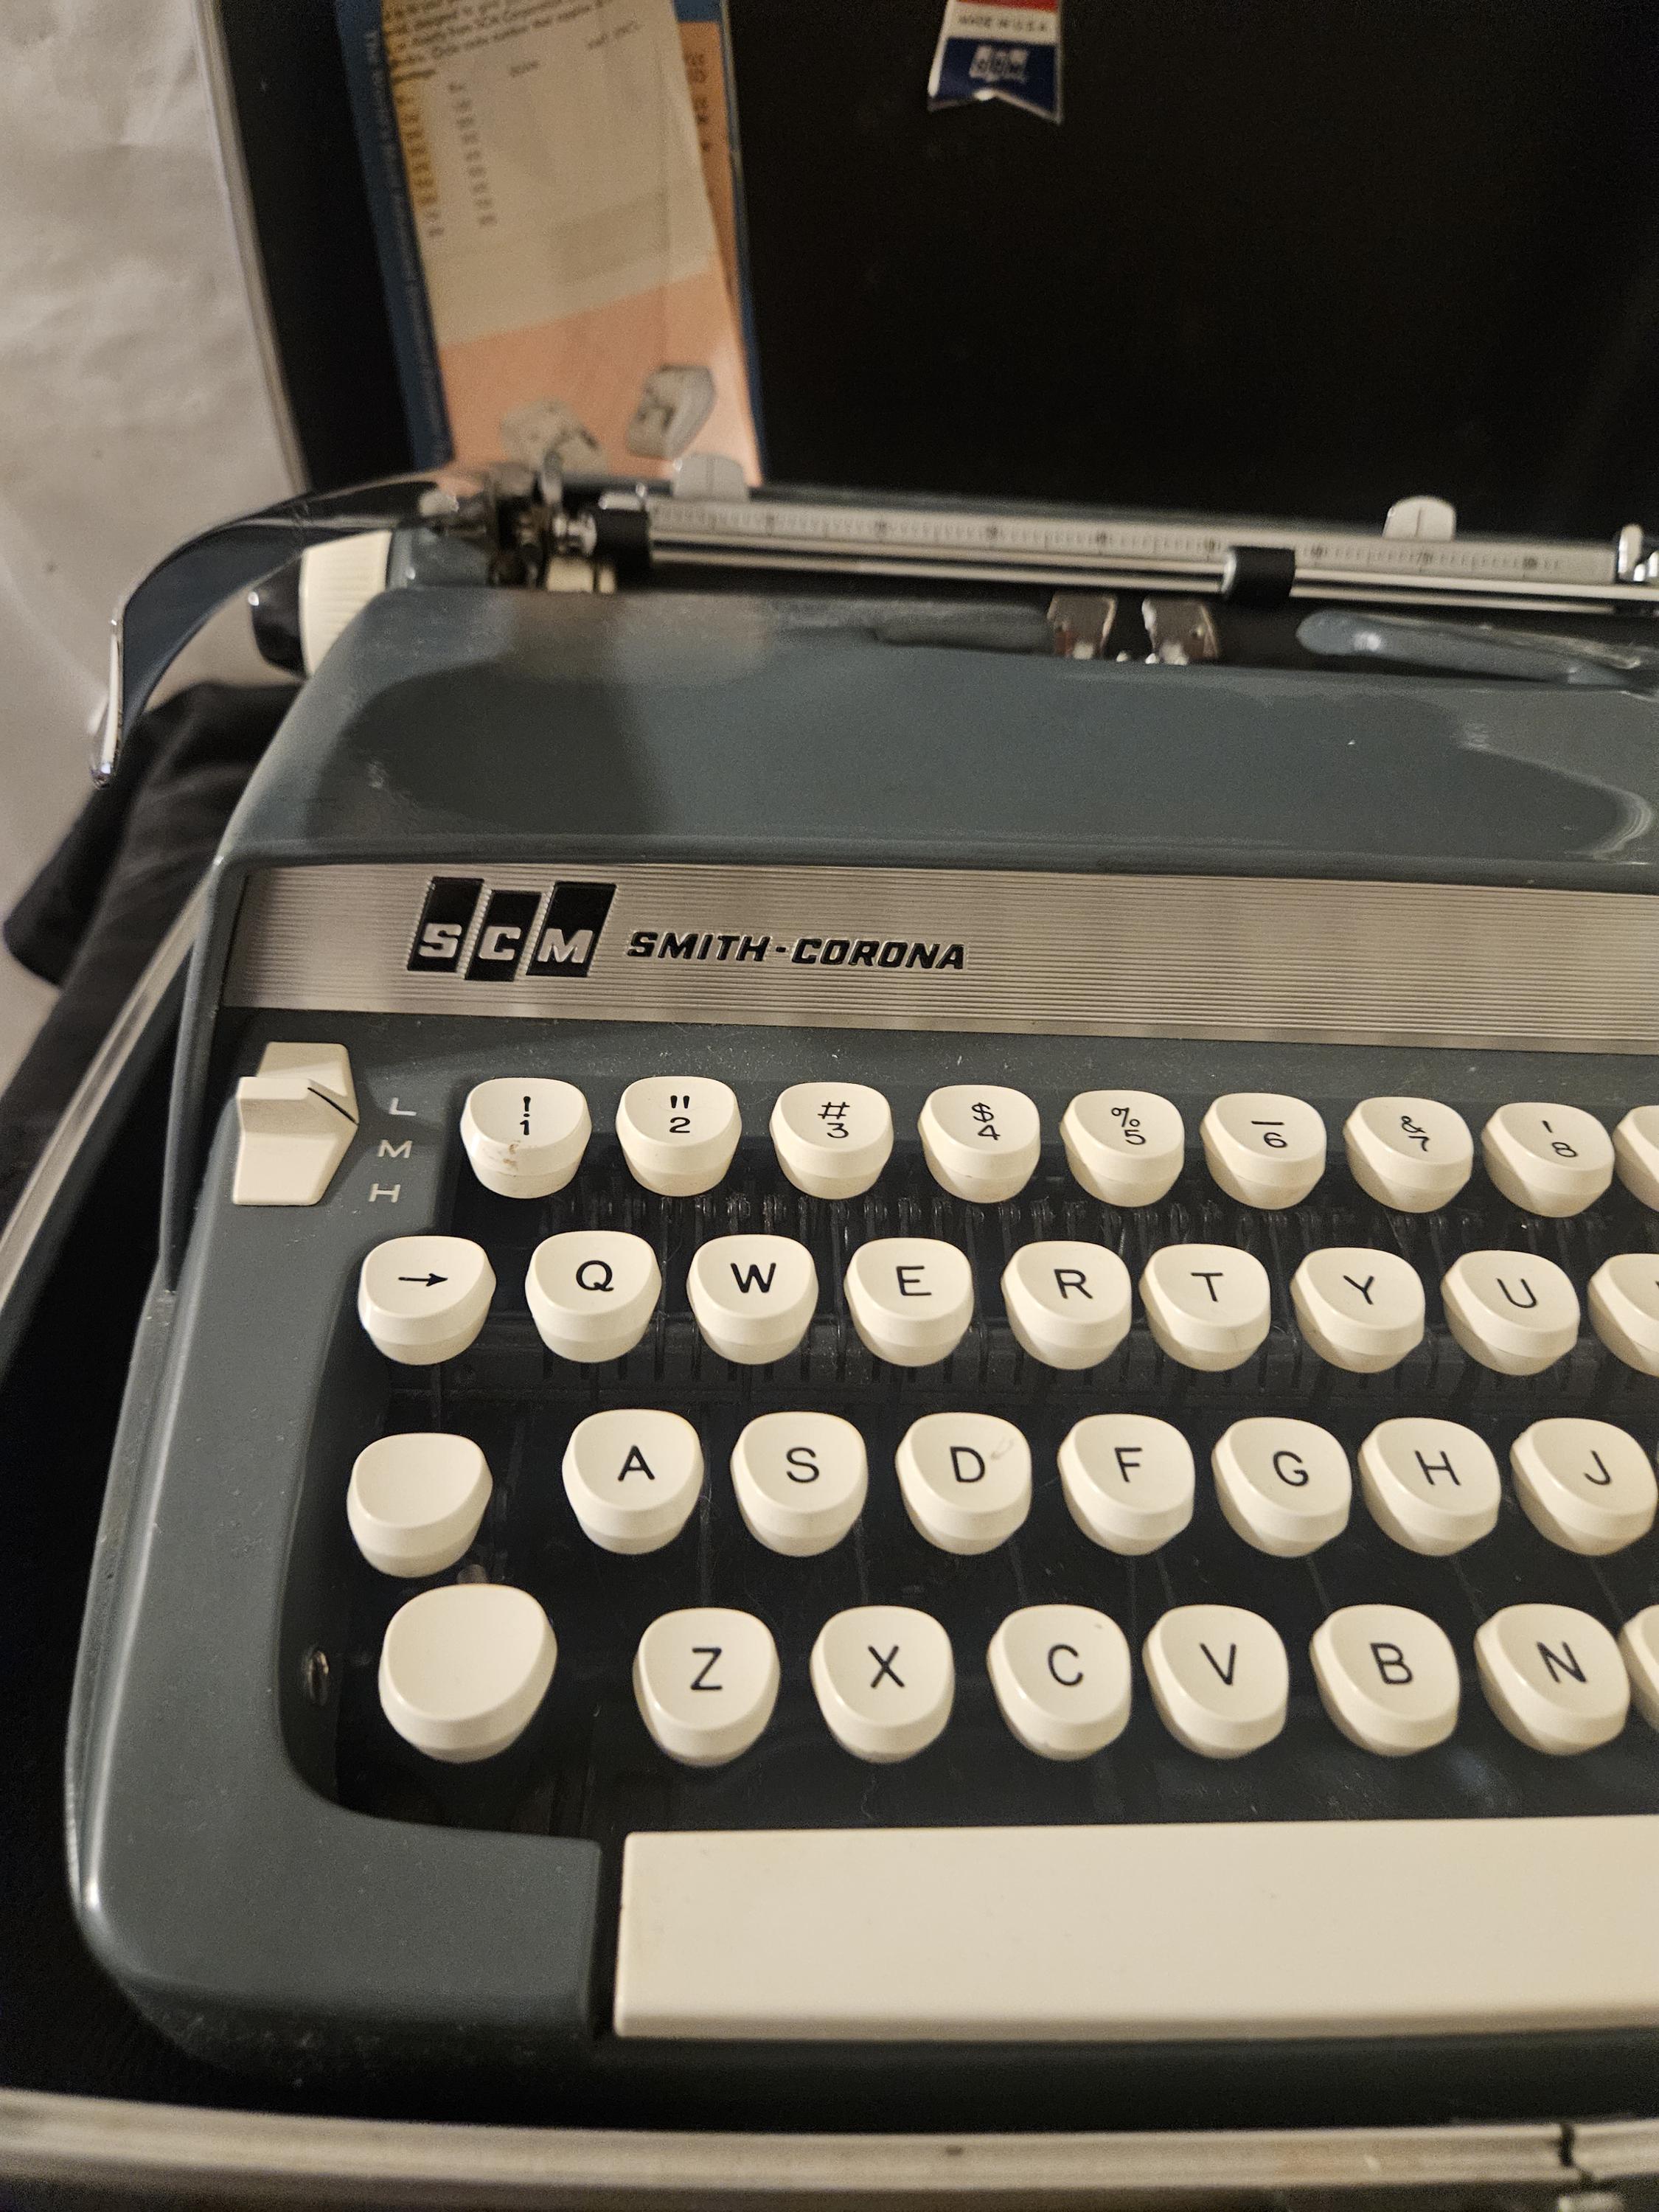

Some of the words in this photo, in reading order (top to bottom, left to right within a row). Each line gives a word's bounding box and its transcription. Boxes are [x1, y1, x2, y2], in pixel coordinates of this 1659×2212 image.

[419, 924, 593, 964] SCM
[627, 931, 964, 970] SMITH-CORONA
[389, 1097, 417, 1116] L
[523, 1096, 532, 1118] !
[817, 1102, 850, 1120] #
[971, 1102, 995, 1124] $
[1110, 1107, 1141, 1127] %
[519, 1119, 530, 1136] 1
[669, 1116, 691, 1134] 2
[827, 1122, 849, 1138] 3
[977, 1124, 1001, 1141] 4
[1124, 1129, 1147, 1146] 5
[1401, 1115, 1426, 1133] &
[377, 1139, 412, 1159] M
[1263, 1132, 1288, 1149] 6
[1408, 1135, 1430, 1152] 7
[1551, 1141, 1578, 1158] 8
[369, 1183, 401, 1203] H
[575, 1259, 614, 1293] Q
[730, 1262, 776, 1294] W
[895, 1265, 932, 1297] E
[1054, 1268, 1093, 1299] R
[1191, 1272, 1223, 1302] T
[1343, 1275, 1374, 1305] Y
[1497, 1278, 1537, 1309] U
[617, 1445, 655, 1482] A
[786, 1447, 820, 1484] S
[950, 1446, 986, 1484] D
[1114, 1447, 1143, 1483] F
[1273, 1450, 1310, 1487] G
[1414, 1450, 1461, 1486] H
[1584, 1450, 1612, 1486] J
[689, 1647, 723, 1691] Z
[868, 1645, 905, 1688] X
[1048, 1644, 1084, 1687] C
[1200, 1643, 1237, 1686] V
[1370, 1642, 1413, 1686] B
[1537, 1641, 1587, 1683] N
